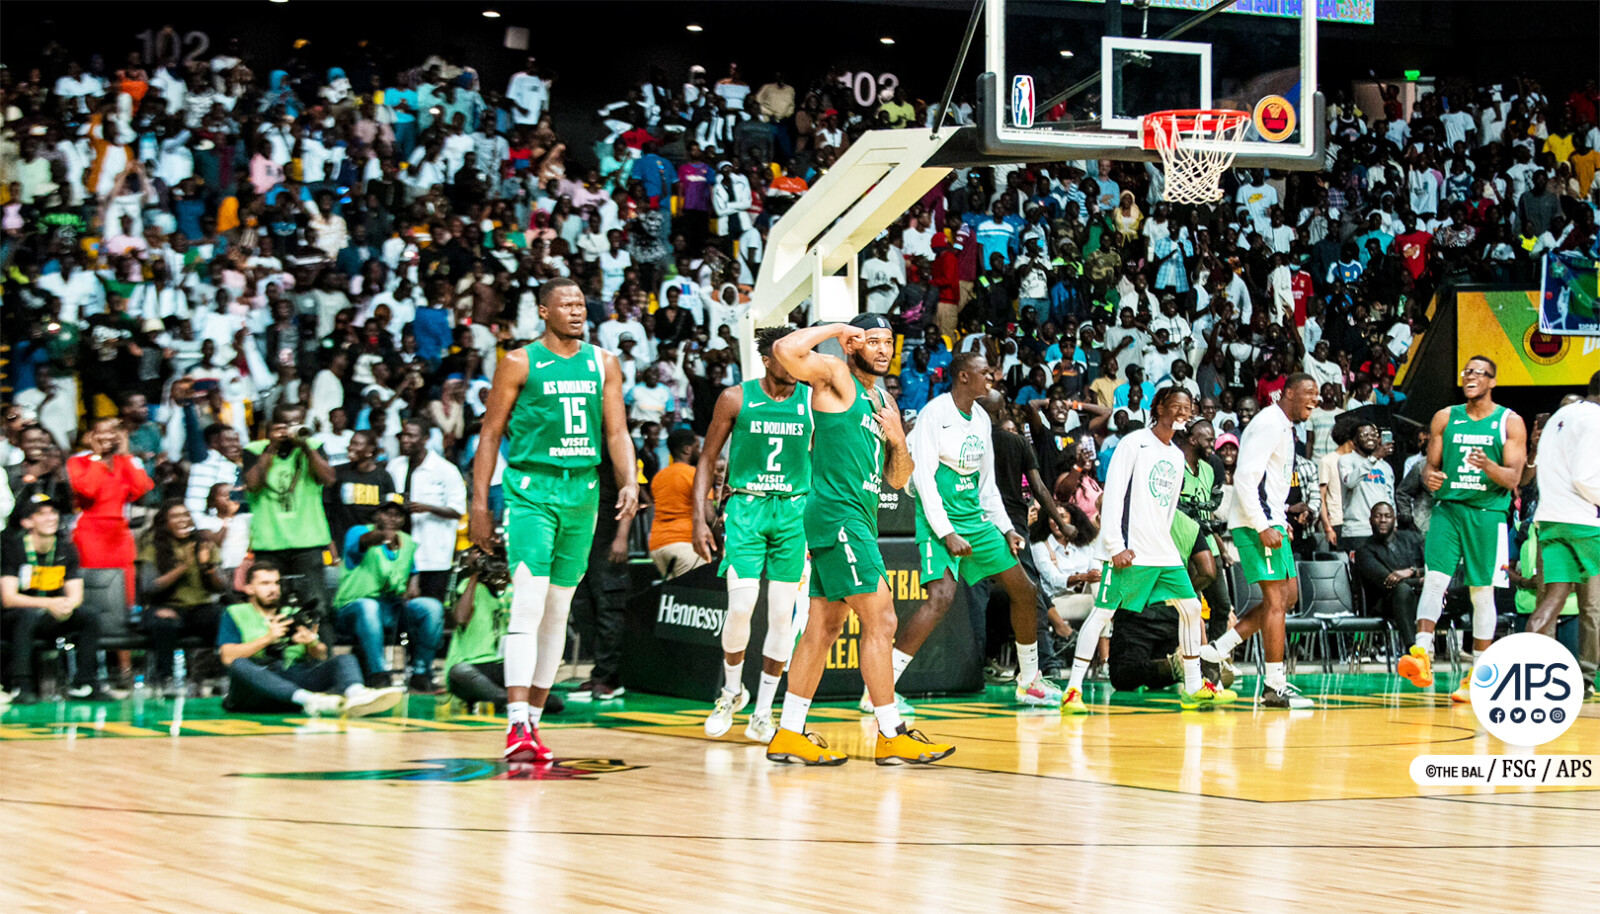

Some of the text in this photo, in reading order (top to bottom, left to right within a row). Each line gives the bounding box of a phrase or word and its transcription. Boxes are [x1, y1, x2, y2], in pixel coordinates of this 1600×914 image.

[543, 380, 597, 395] AS DOUANES
[559, 397, 587, 434] 15
[750, 420, 804, 436] AS DOUANES
[560, 437, 589, 447] VISIT
[549, 447, 597, 456] RWANDA
[766, 437, 783, 472] 2
[757, 474, 785, 483] VISIT
[745, 482, 793, 492] RWANDA
[657, 594, 728, 637] Hennessy
